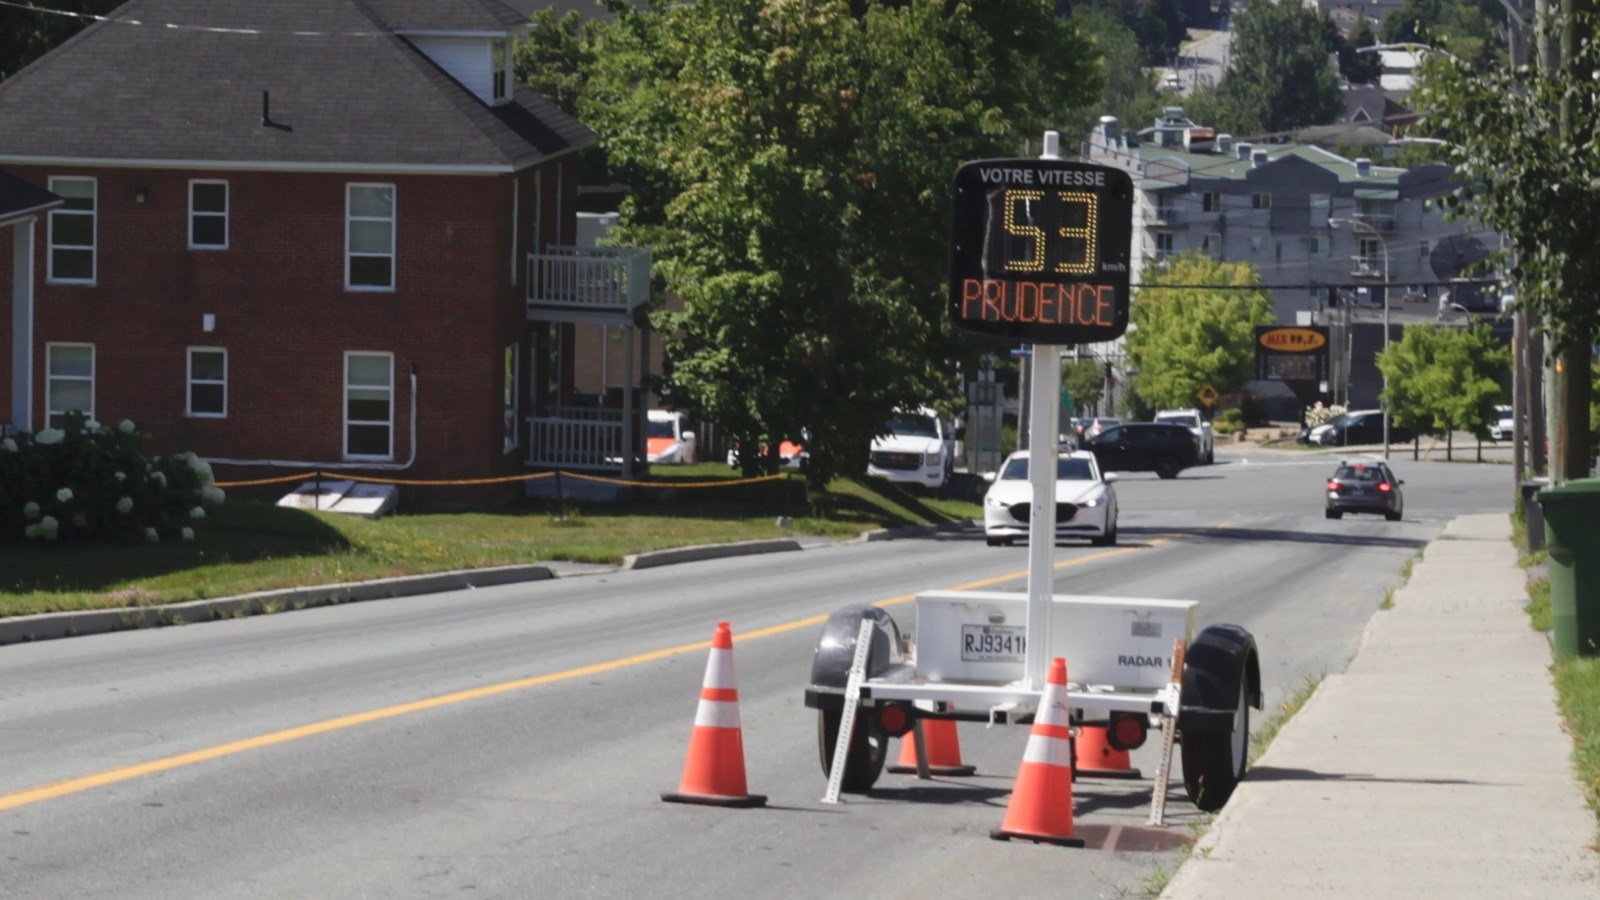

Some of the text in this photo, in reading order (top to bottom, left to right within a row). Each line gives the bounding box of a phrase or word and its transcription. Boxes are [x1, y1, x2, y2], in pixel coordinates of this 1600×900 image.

[980, 168, 1105, 186] VOTRE VITESSE
[1004, 190, 1098, 274] 53
[1101, 261, 1126, 272] km/h
[962, 279, 1114, 326] PRUDENCE
[1118, 655, 1162, 668] RADAR
